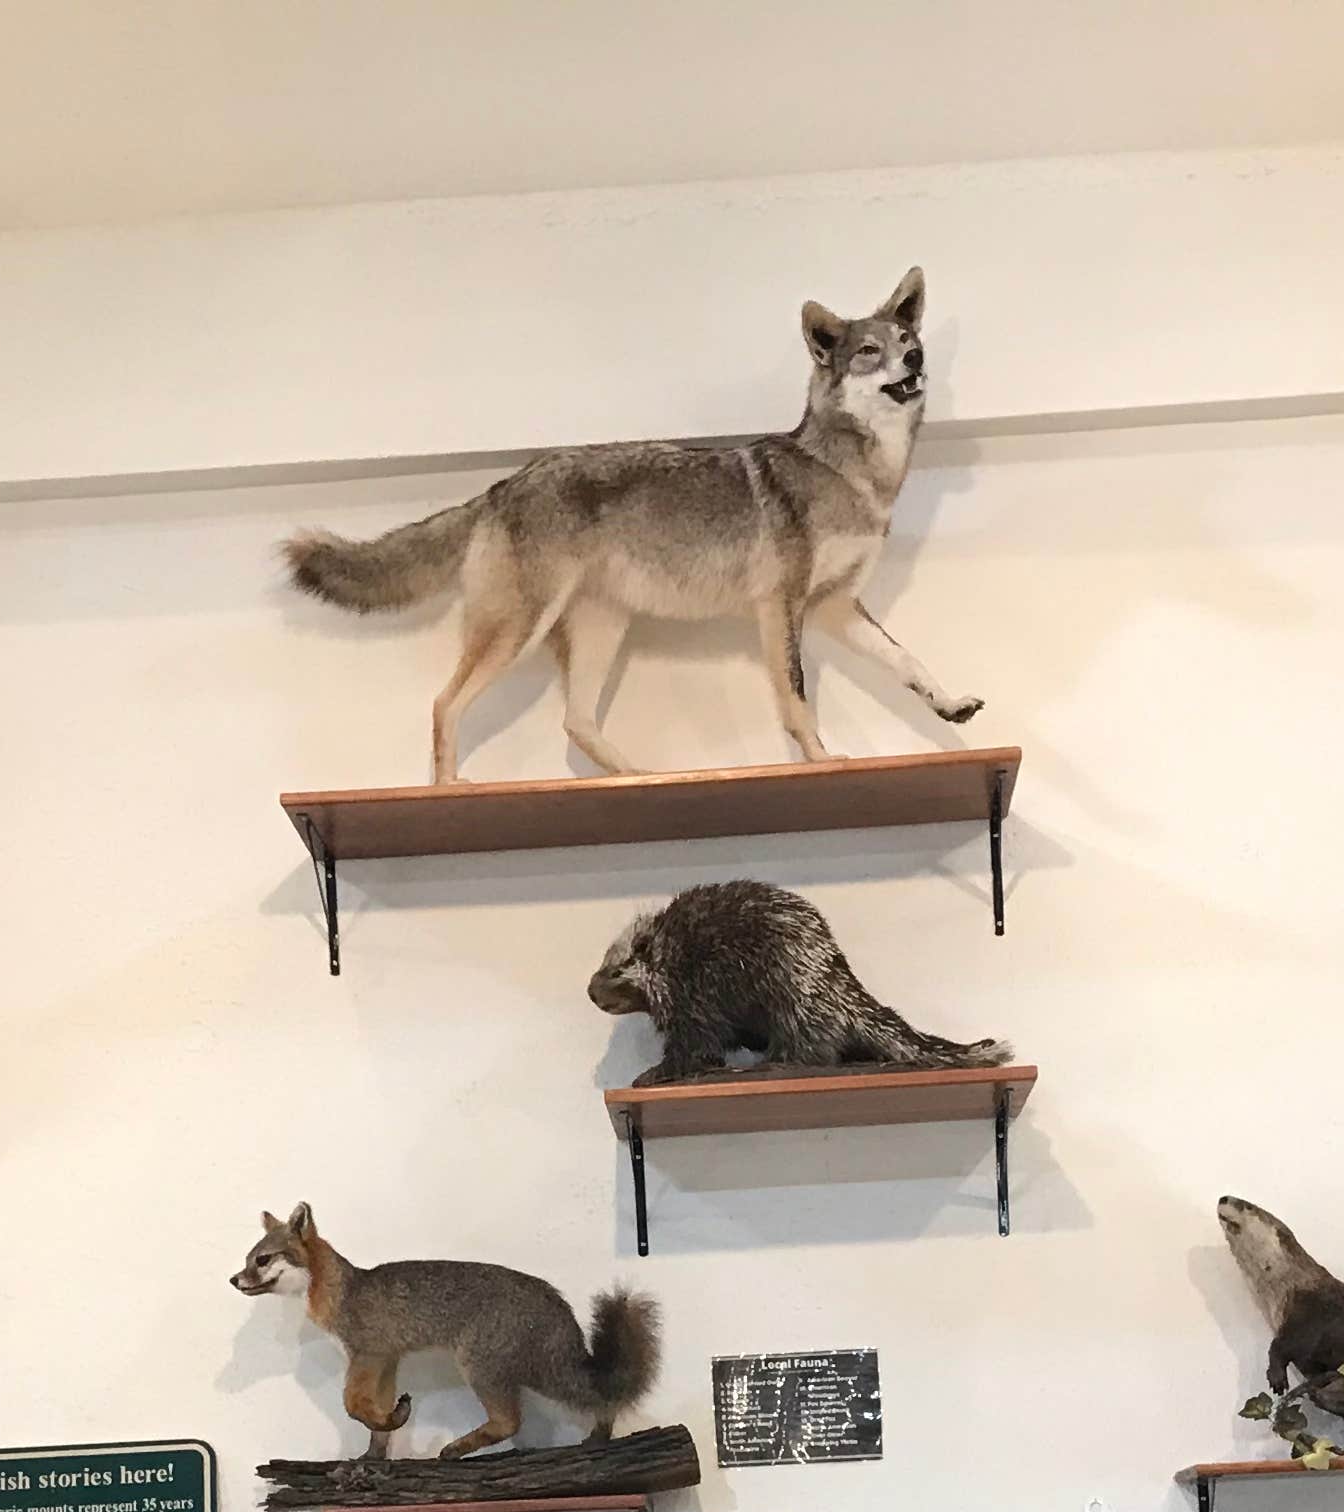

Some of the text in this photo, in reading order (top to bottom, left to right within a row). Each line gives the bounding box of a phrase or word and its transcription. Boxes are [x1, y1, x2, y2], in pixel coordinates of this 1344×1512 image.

[761, 1358, 829, 1370] Local Fauna
[39, 1468, 112, 1488] stories
[120, 1463, 174, 1483] here!
[142, 1500, 157, 1512] 35
